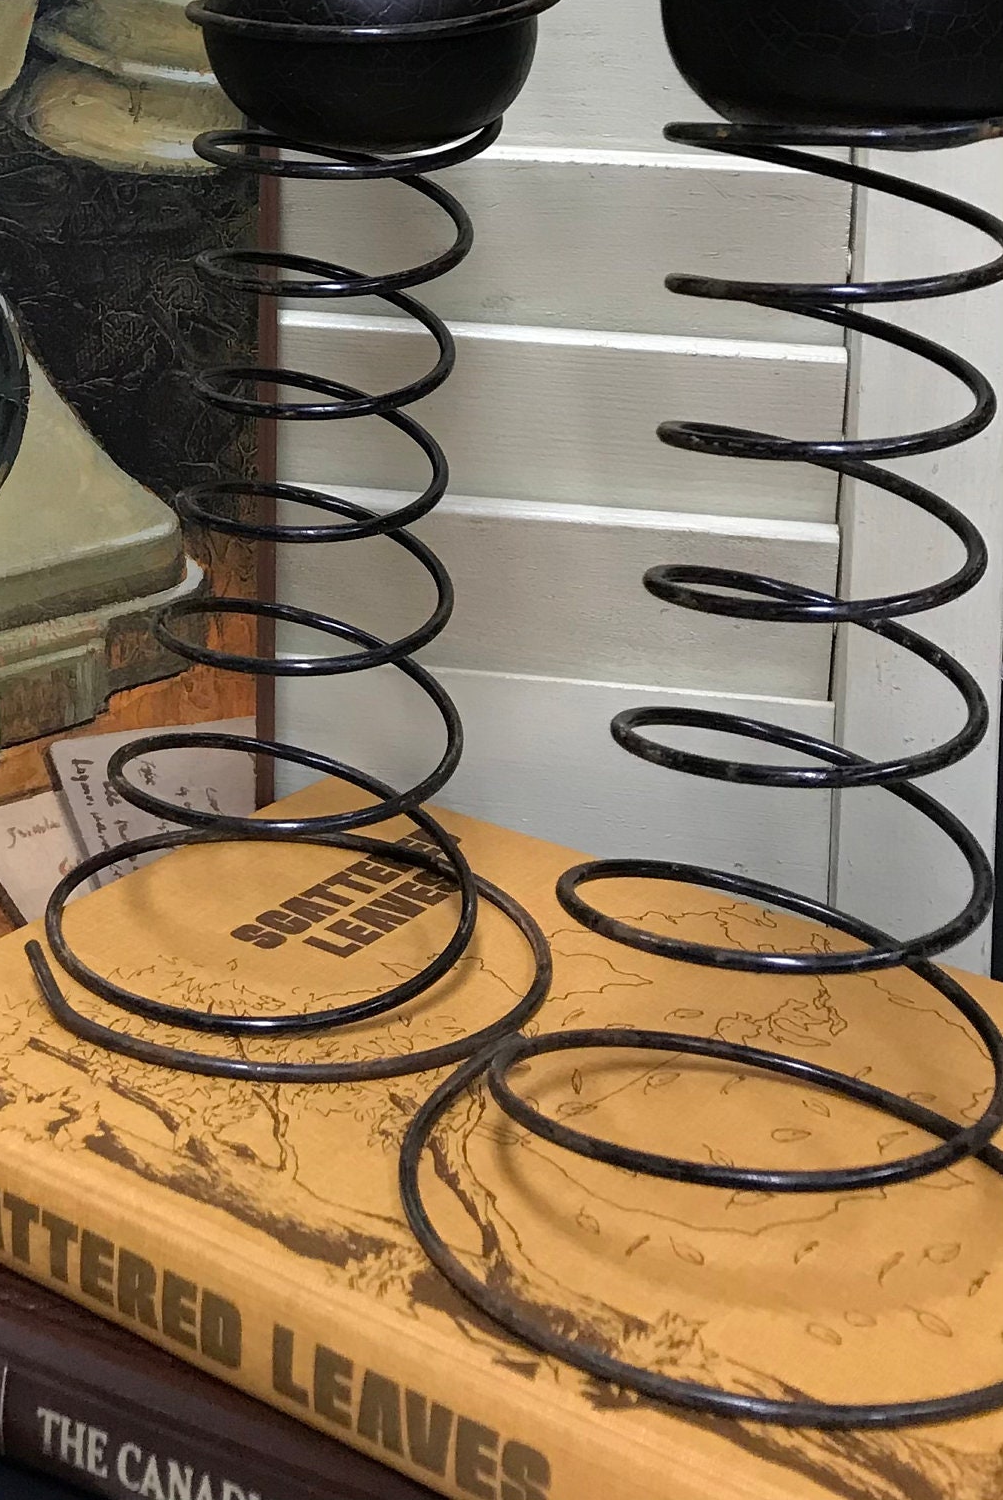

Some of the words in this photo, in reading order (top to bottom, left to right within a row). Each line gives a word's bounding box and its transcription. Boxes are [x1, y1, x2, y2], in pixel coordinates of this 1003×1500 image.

[301, 869, 463, 959] LEAVES
[36, 1406, 109, 1479] THE
[116, 1441, 262, 1500] CANA
[271, 1322, 552, 1500] LEAVES
